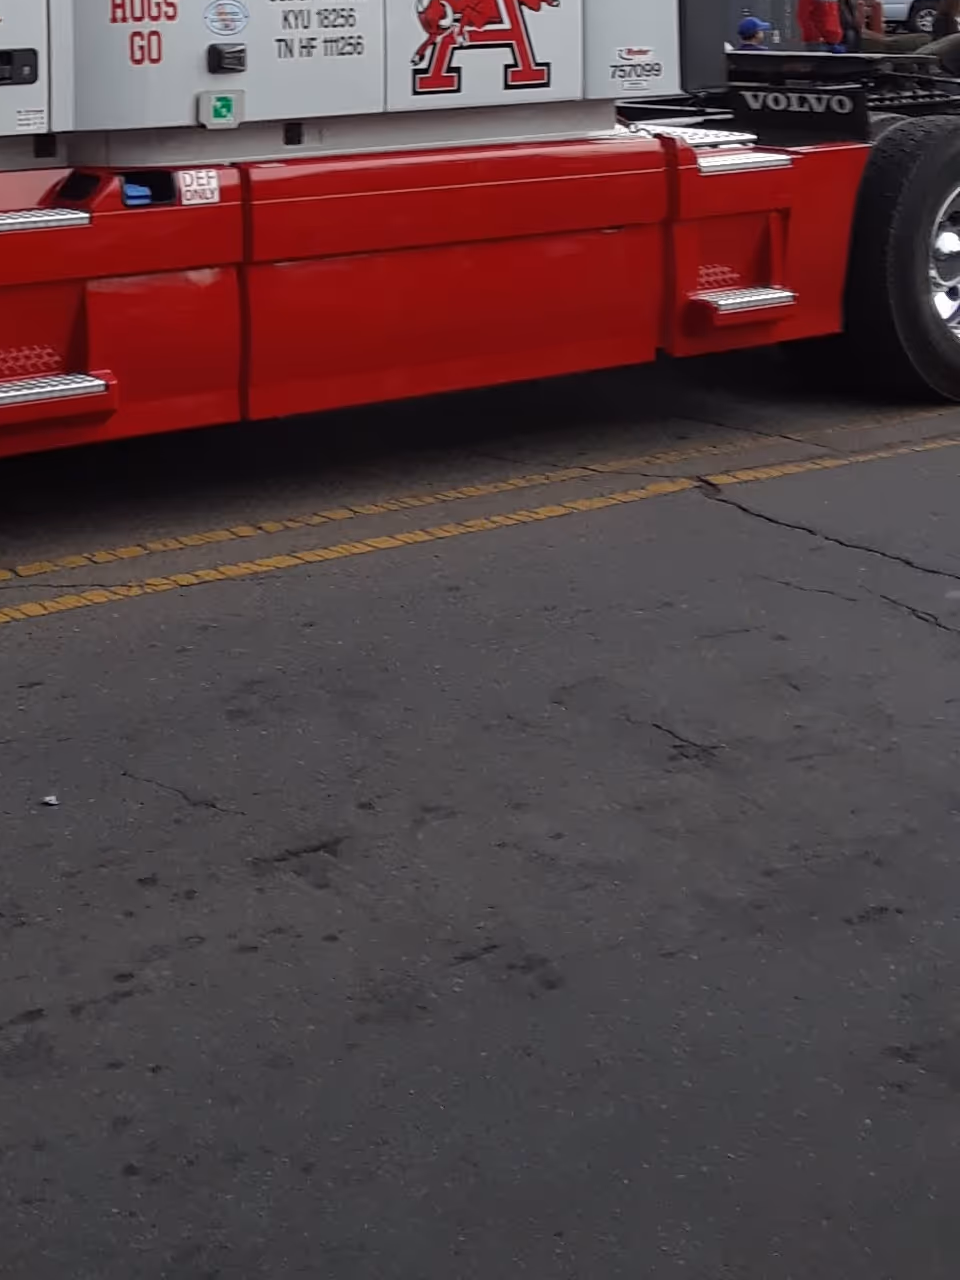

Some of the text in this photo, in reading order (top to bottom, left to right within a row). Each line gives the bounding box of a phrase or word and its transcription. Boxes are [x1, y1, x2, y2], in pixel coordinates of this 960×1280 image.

[282, 9, 311, 29] KYU
[129, 30, 162, 65] GO
[275, 38, 295, 59] TN
[299, 37, 317, 57] HF
[609, 62, 662, 79] 757099
[738, 90, 854, 114] VOLVO
[182, 170, 217, 188] DEF
[183, 186, 218, 202] ONLY
